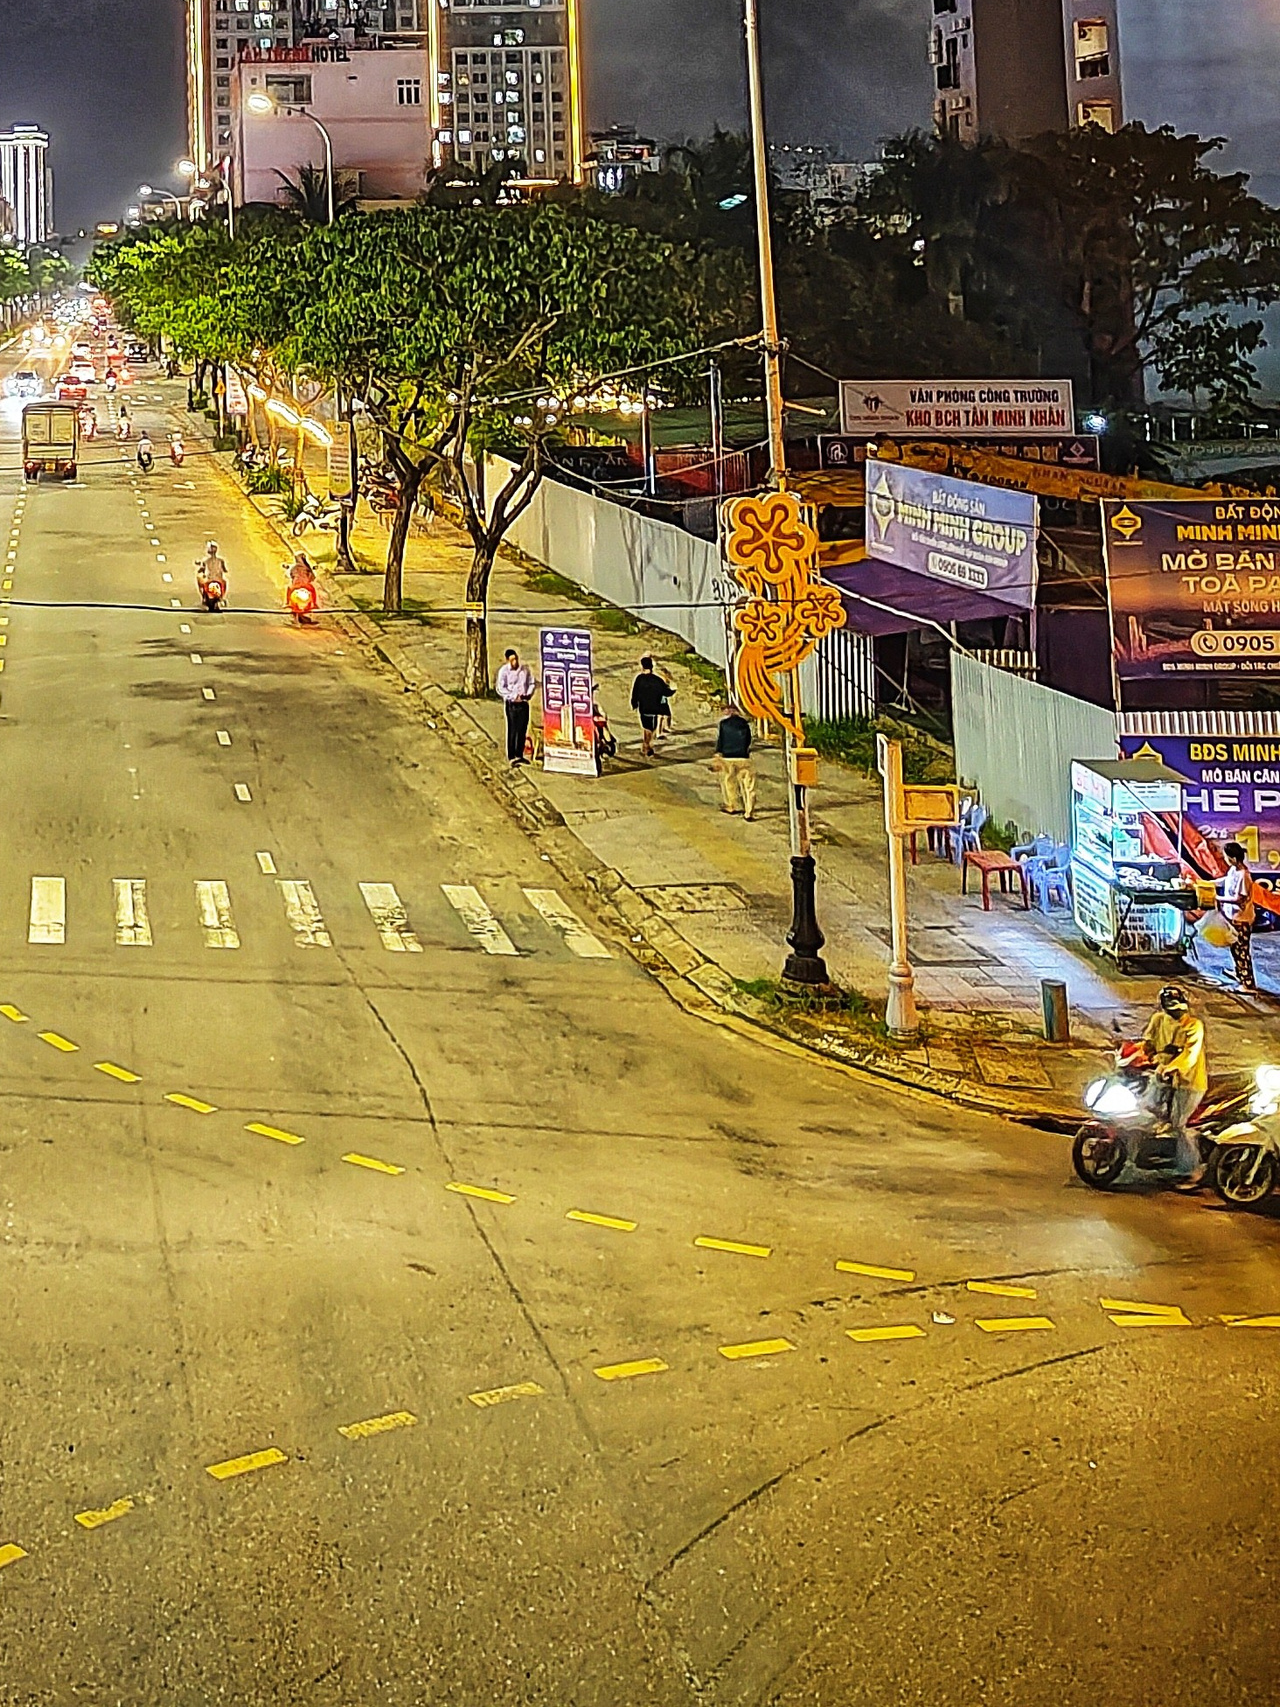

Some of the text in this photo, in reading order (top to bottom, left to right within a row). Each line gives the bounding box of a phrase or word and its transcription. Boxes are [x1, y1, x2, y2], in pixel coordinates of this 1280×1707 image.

[311, 44, 351, 63] HOTEL
[905, 409, 932, 427] KHO
[934, 409, 961, 427] BCH
[992, 409, 1026, 427] MINH
[1215, 502, 1245, 520] BẤT
[896, 501, 932, 530] MINH
[932, 510, 970, 542] MINH
[971, 519, 1027, 556] GROUP
[1176, 524, 1280, 541] MINH MIN
[1222, 635, 1275, 652] 0905
[1190, 743, 1280, 761] BĐS MINH
